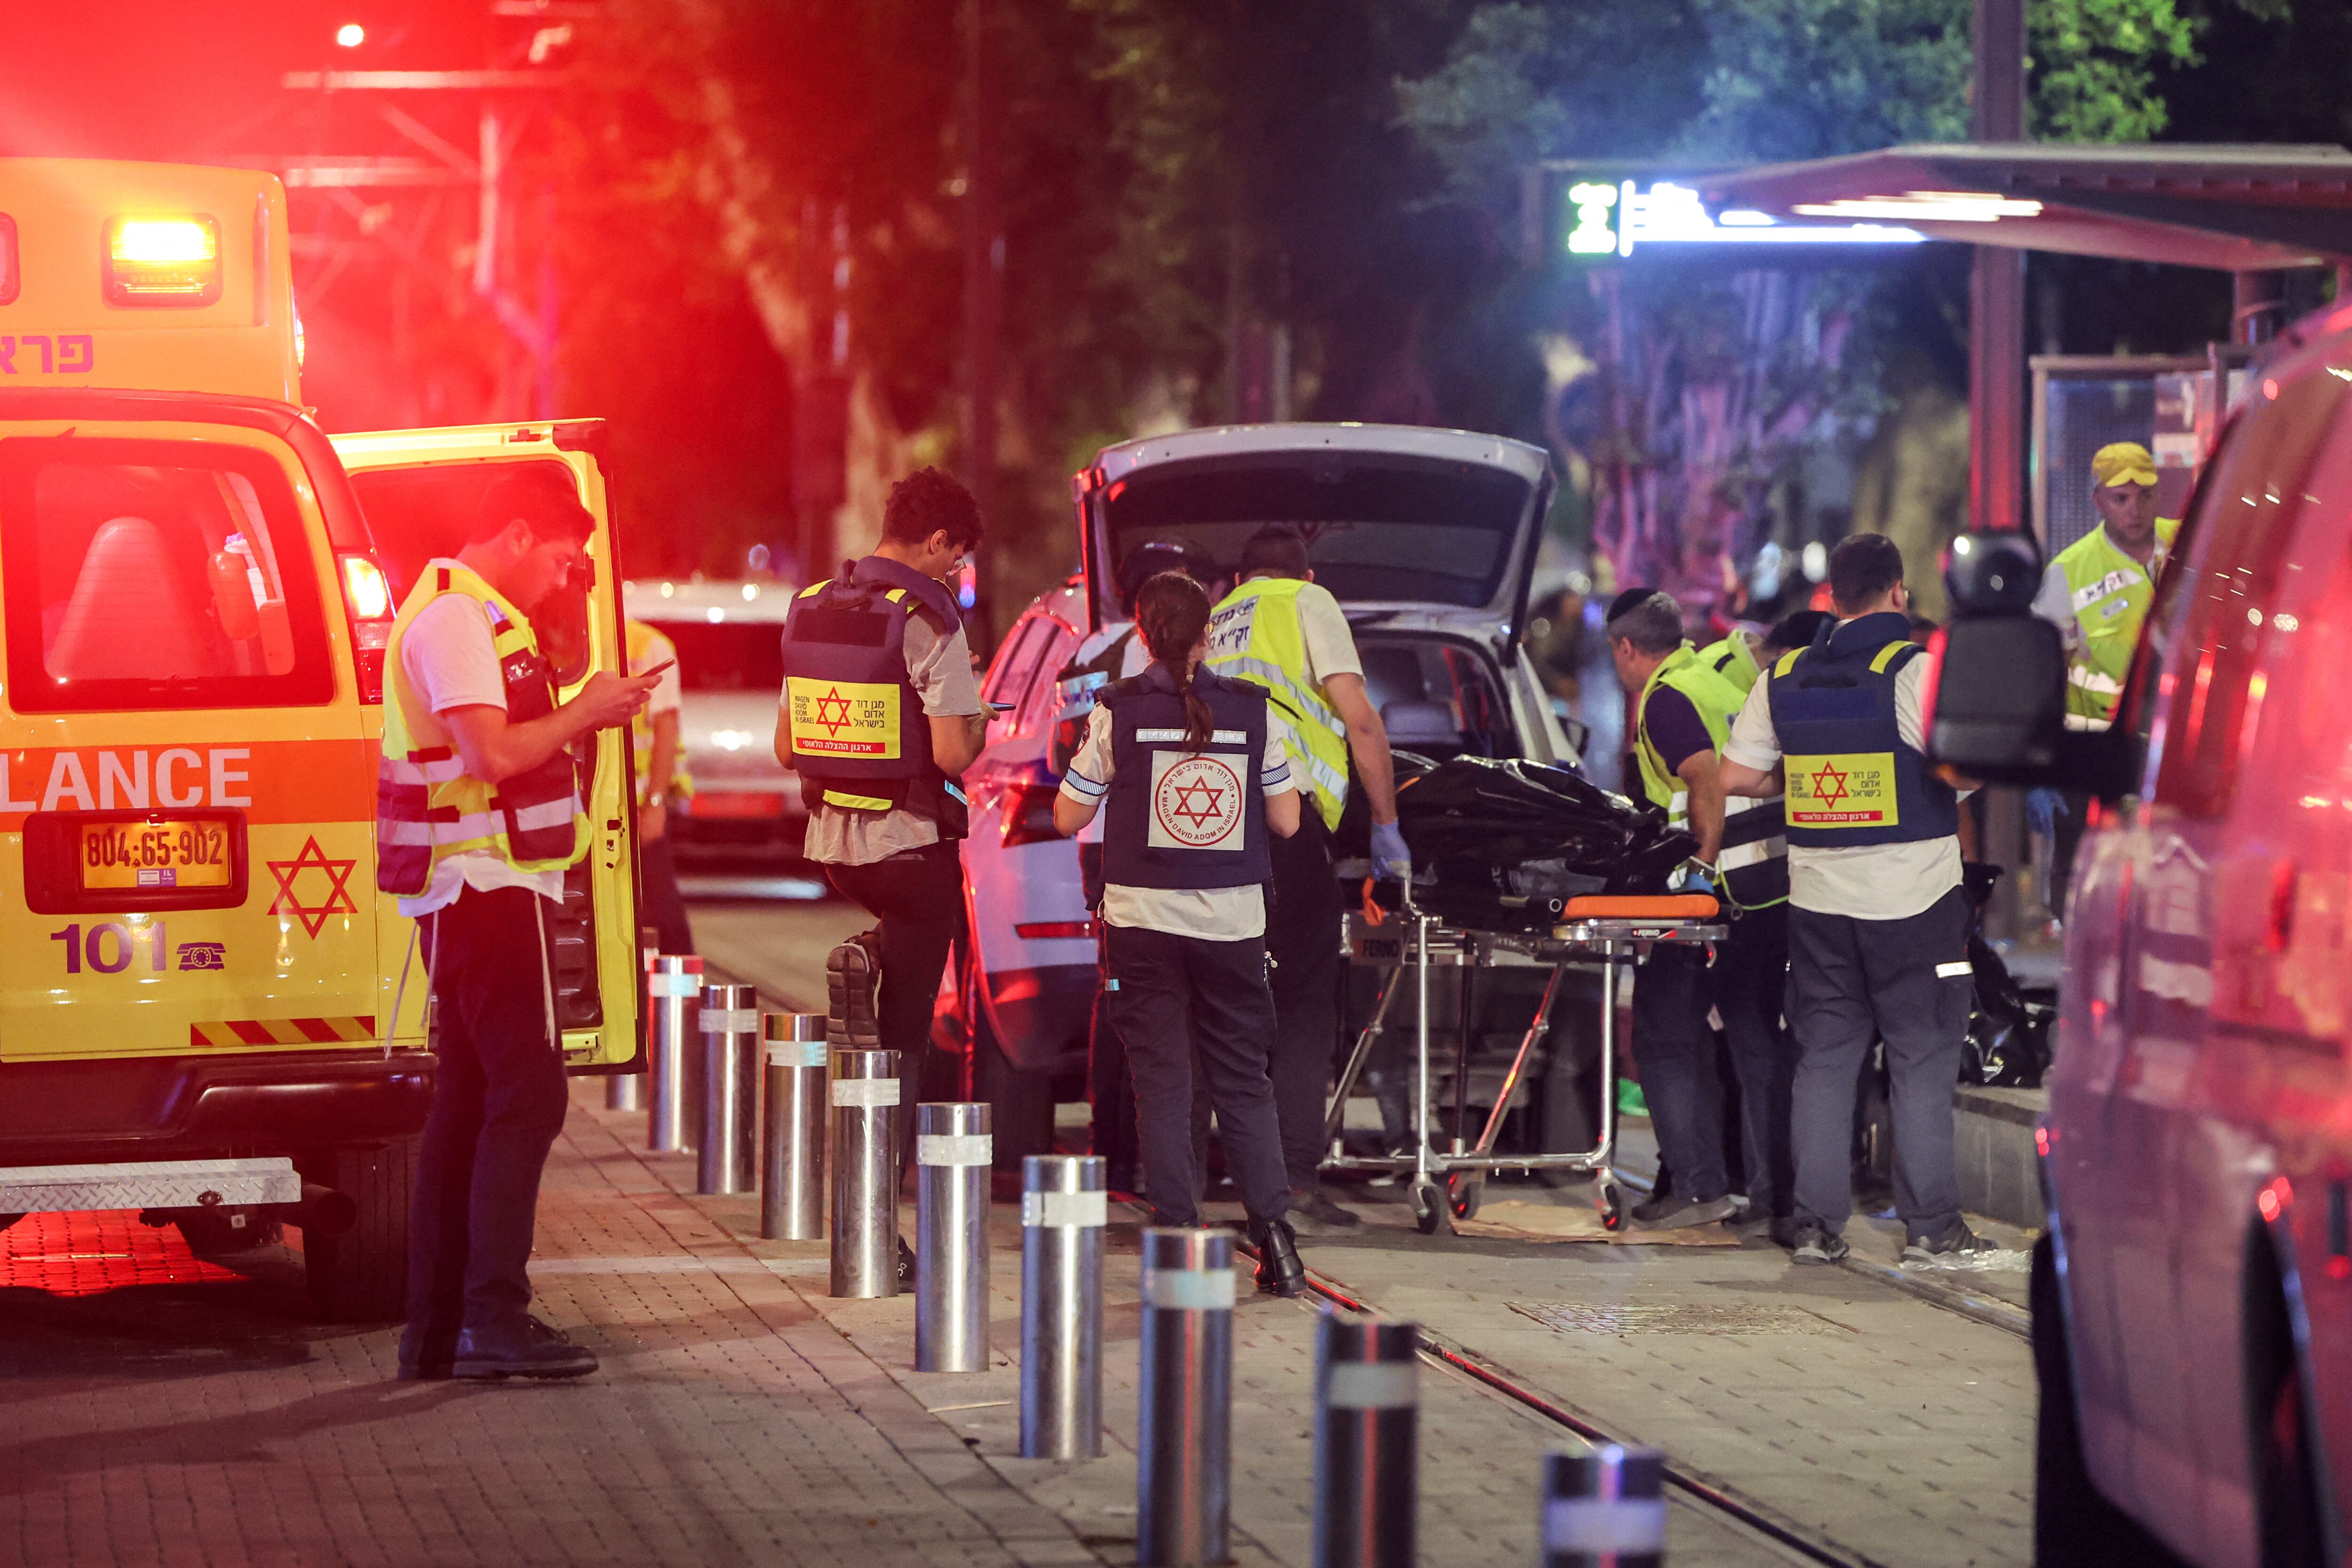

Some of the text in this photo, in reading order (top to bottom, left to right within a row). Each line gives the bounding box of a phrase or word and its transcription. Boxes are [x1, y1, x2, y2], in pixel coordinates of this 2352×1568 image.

[871, 700, 884, 710] מגן
[853, 718, 885, 728] בישראל
[803, 740, 872, 753] ארגון ההצלה הלאומי
[1164, 765, 1191, 788] בישראל
[1217, 768, 1228, 779] דוד
[1225, 779, 1235, 792] מגן
[1162, 797, 1174, 824] MAGEN
[1172, 823, 1192, 839] DAVID
[1194, 831, 1216, 840] ADOM
[1223, 800, 1235, 826] ISRAEL
[51, 922, 166, 973] 101
